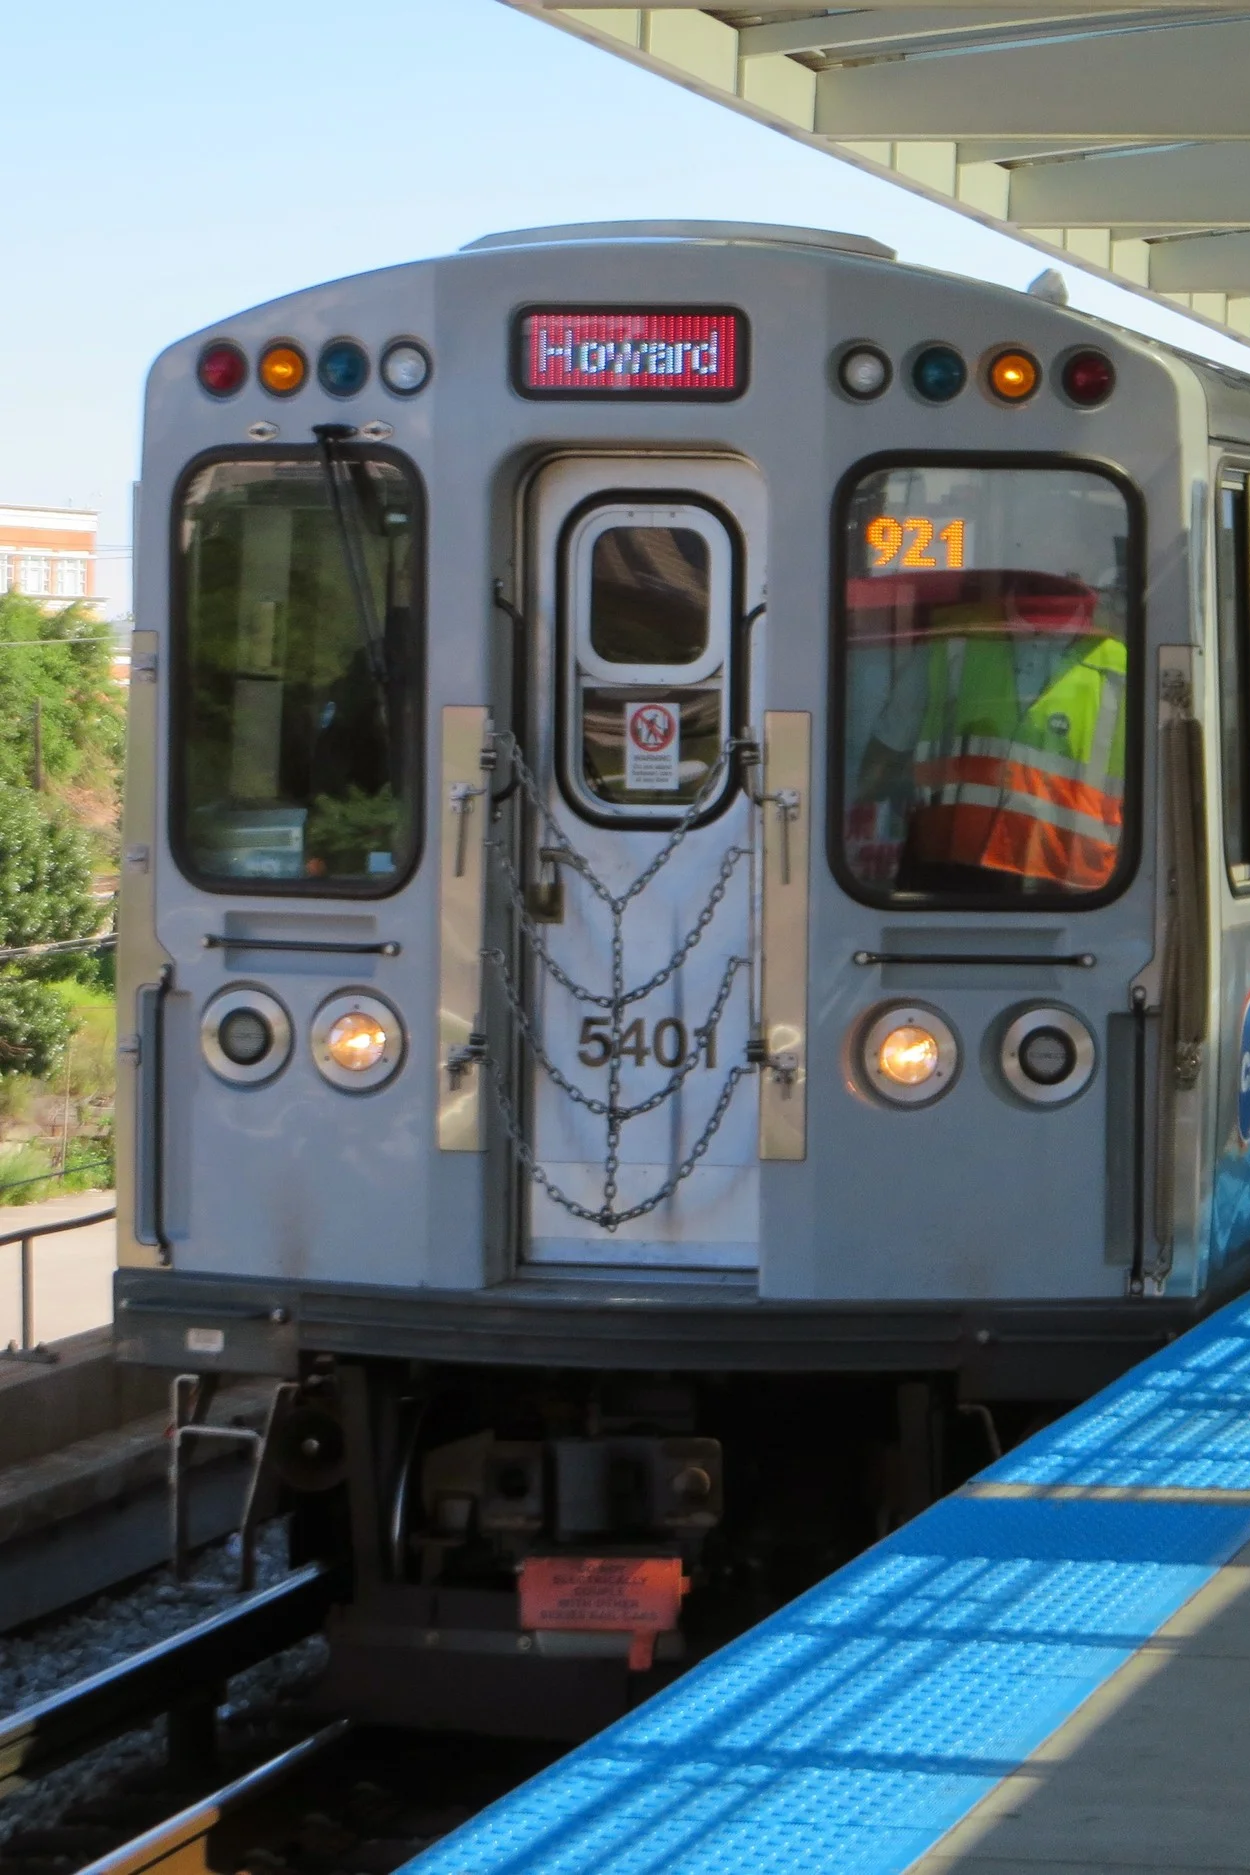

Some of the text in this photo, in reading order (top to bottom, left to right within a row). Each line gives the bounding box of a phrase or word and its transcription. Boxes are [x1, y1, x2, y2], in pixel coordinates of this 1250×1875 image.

[538, 328, 719, 375] Howard
[865, 516, 966, 569] 921
[577, 1015, 717, 1069] 5401
